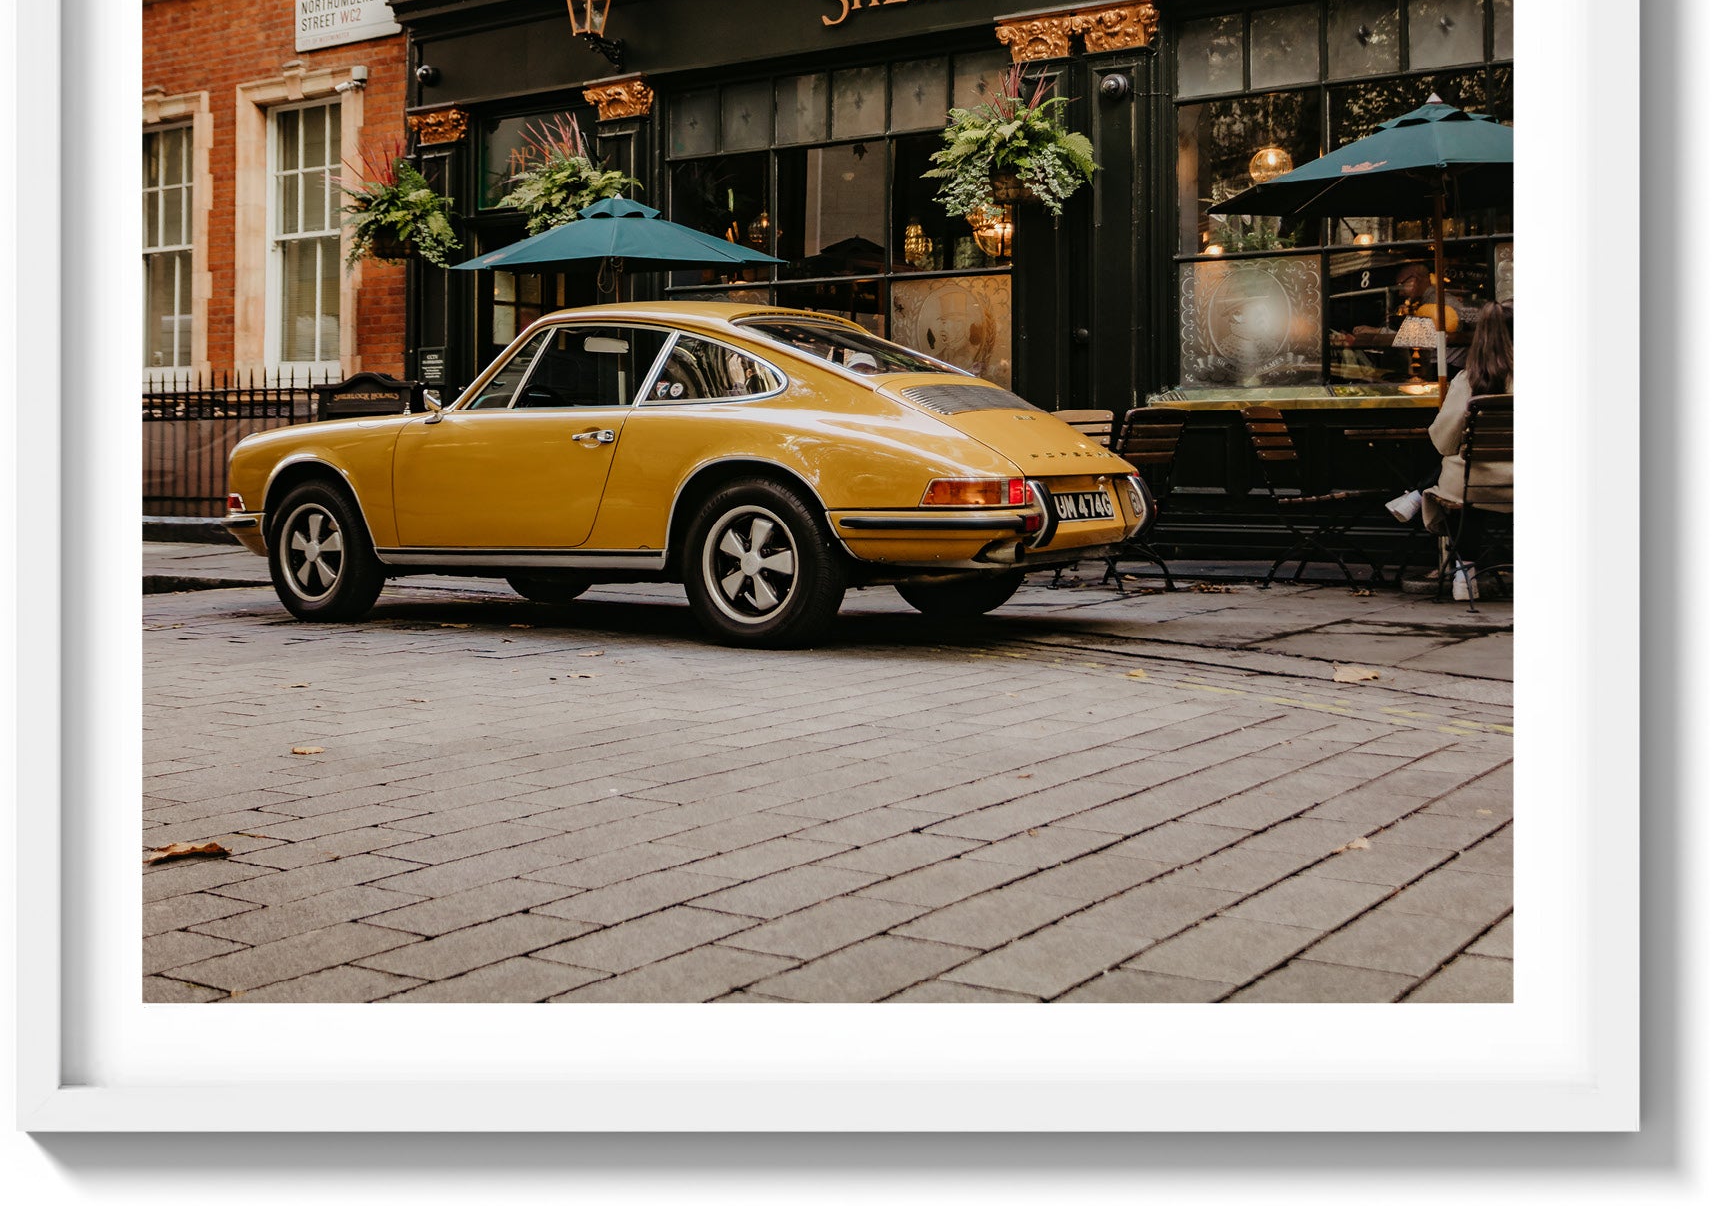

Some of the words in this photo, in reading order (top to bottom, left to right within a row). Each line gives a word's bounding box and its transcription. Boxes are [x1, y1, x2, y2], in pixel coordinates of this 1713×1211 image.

[301, 12, 336, 32] STREET
[340, 7, 362, 24] WC2
[333, 392, 369, 401] SHERLOCK
[370, 392, 400, 400] HOLMES
[1078, 493, 1114, 518] 474G
